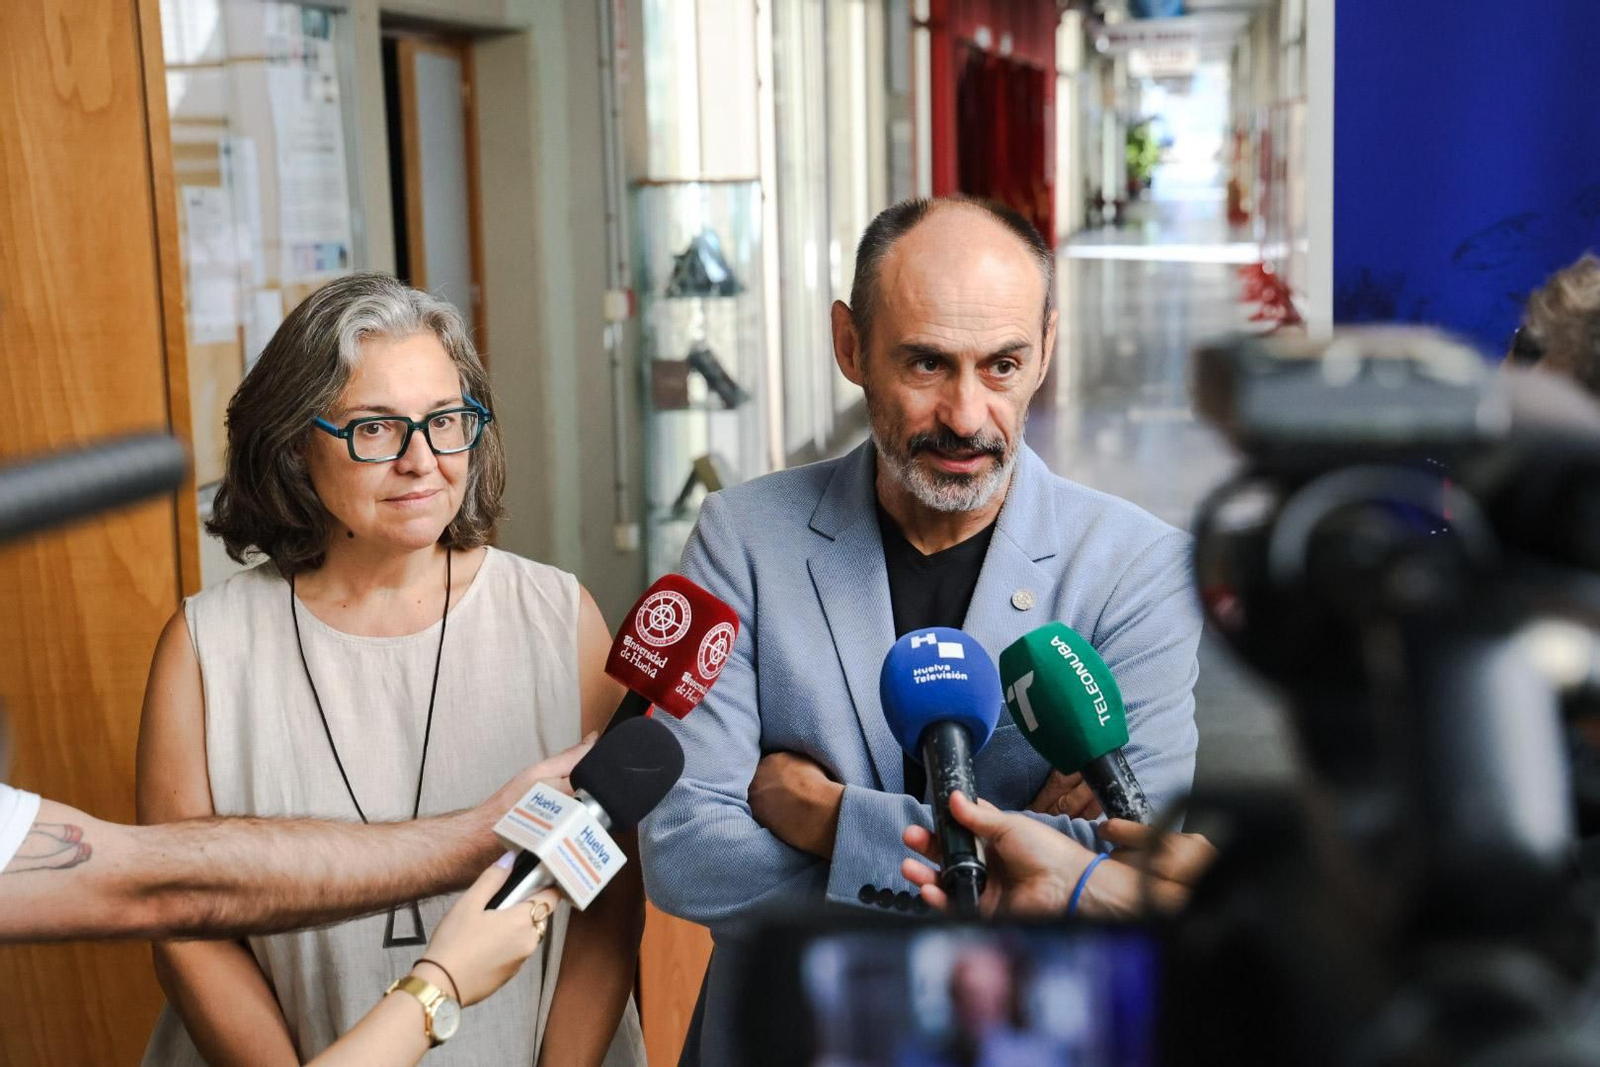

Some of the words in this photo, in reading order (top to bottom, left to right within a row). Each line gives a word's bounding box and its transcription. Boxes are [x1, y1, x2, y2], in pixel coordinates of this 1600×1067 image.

[620, 647, 630, 660] de
[629, 651, 658, 679] Huelva
[623, 634, 668, 668] Universidad
[913, 664, 951, 676] Huelva
[913, 670, 968, 684] Televisión
[1050, 635, 1111, 727] TELEONUBA
[675, 682, 686, 695] de
[531, 791, 562, 814] Huelva
[580, 825, 611, 864] Huelva
